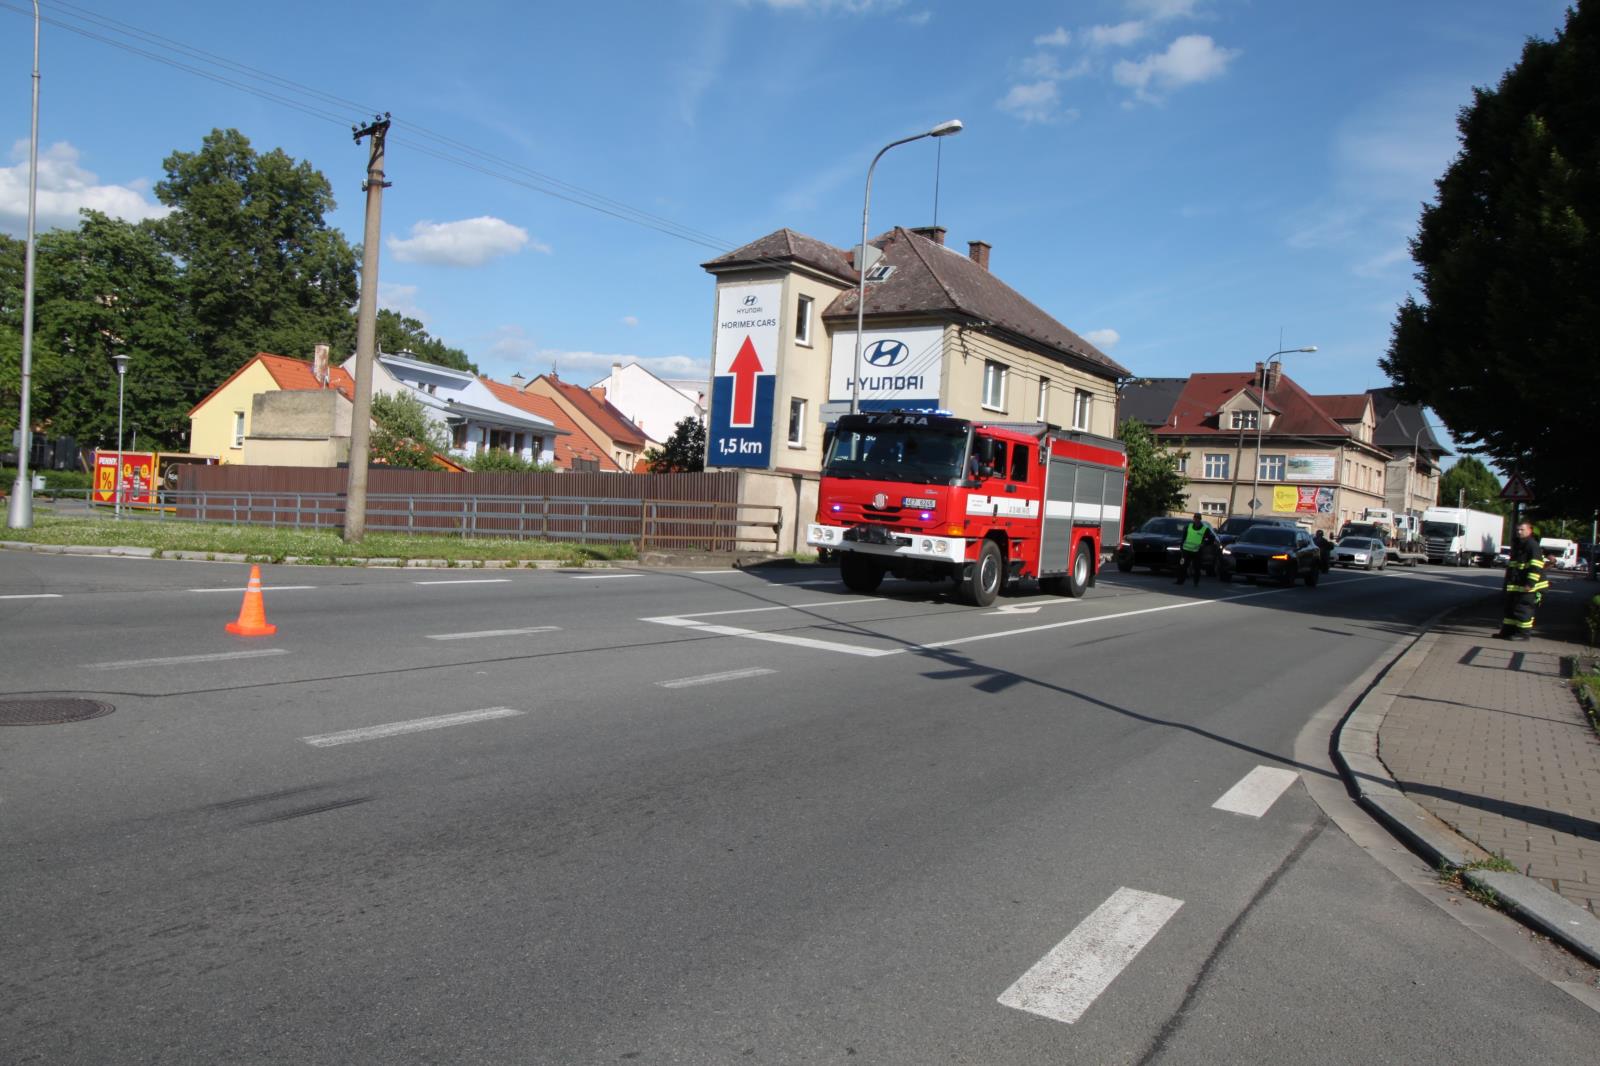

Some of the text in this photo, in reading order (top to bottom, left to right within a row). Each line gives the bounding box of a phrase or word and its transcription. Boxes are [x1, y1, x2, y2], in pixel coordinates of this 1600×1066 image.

[721, 319, 776, 329] HORIMEX CARS
[846, 376, 924, 390] HYUNDAI
[866, 415, 929, 425] TTRA
[719, 438, 762, 455] 1,5 km
